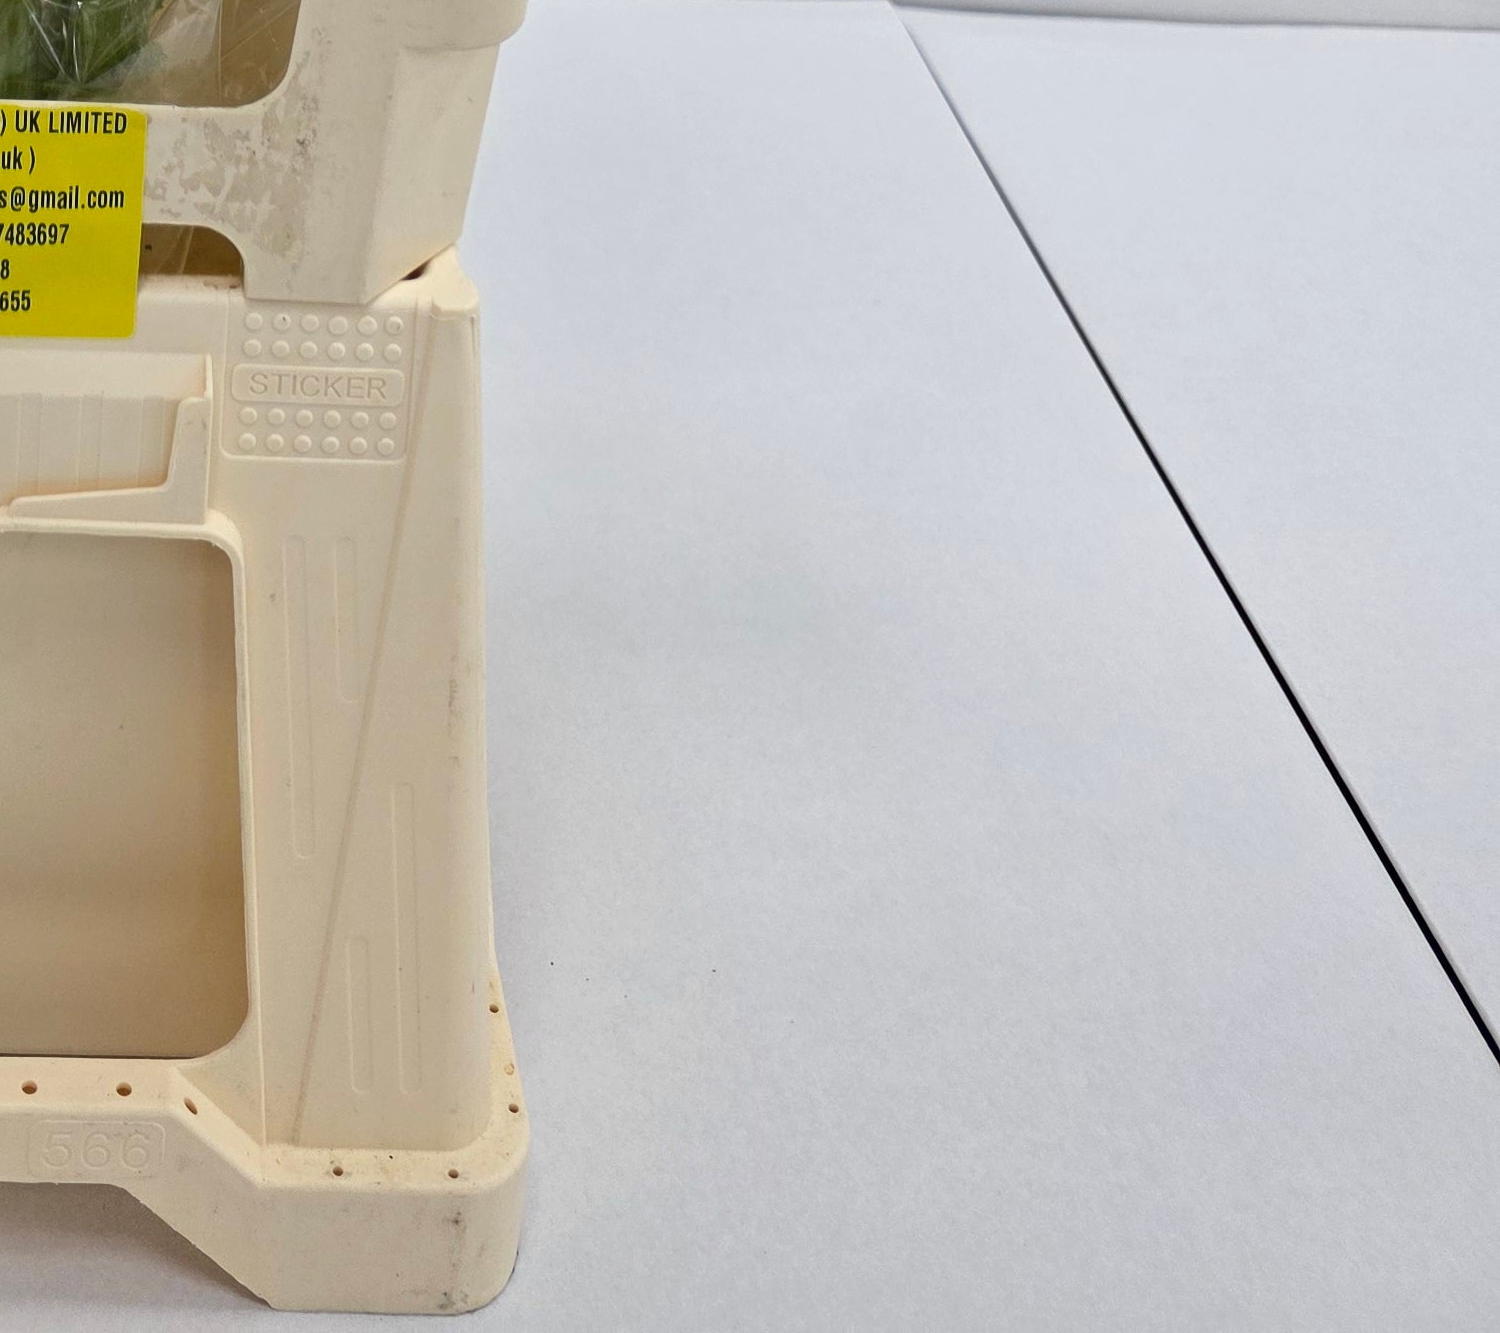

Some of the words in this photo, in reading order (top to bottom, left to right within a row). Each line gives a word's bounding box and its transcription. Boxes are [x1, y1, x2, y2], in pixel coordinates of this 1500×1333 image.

[15, 111, 40, 133] UK
[49, 112, 127, 134] LIMITED
[249, 372, 387, 400] STICKER
[41, 1132, 151, 1170] 566
